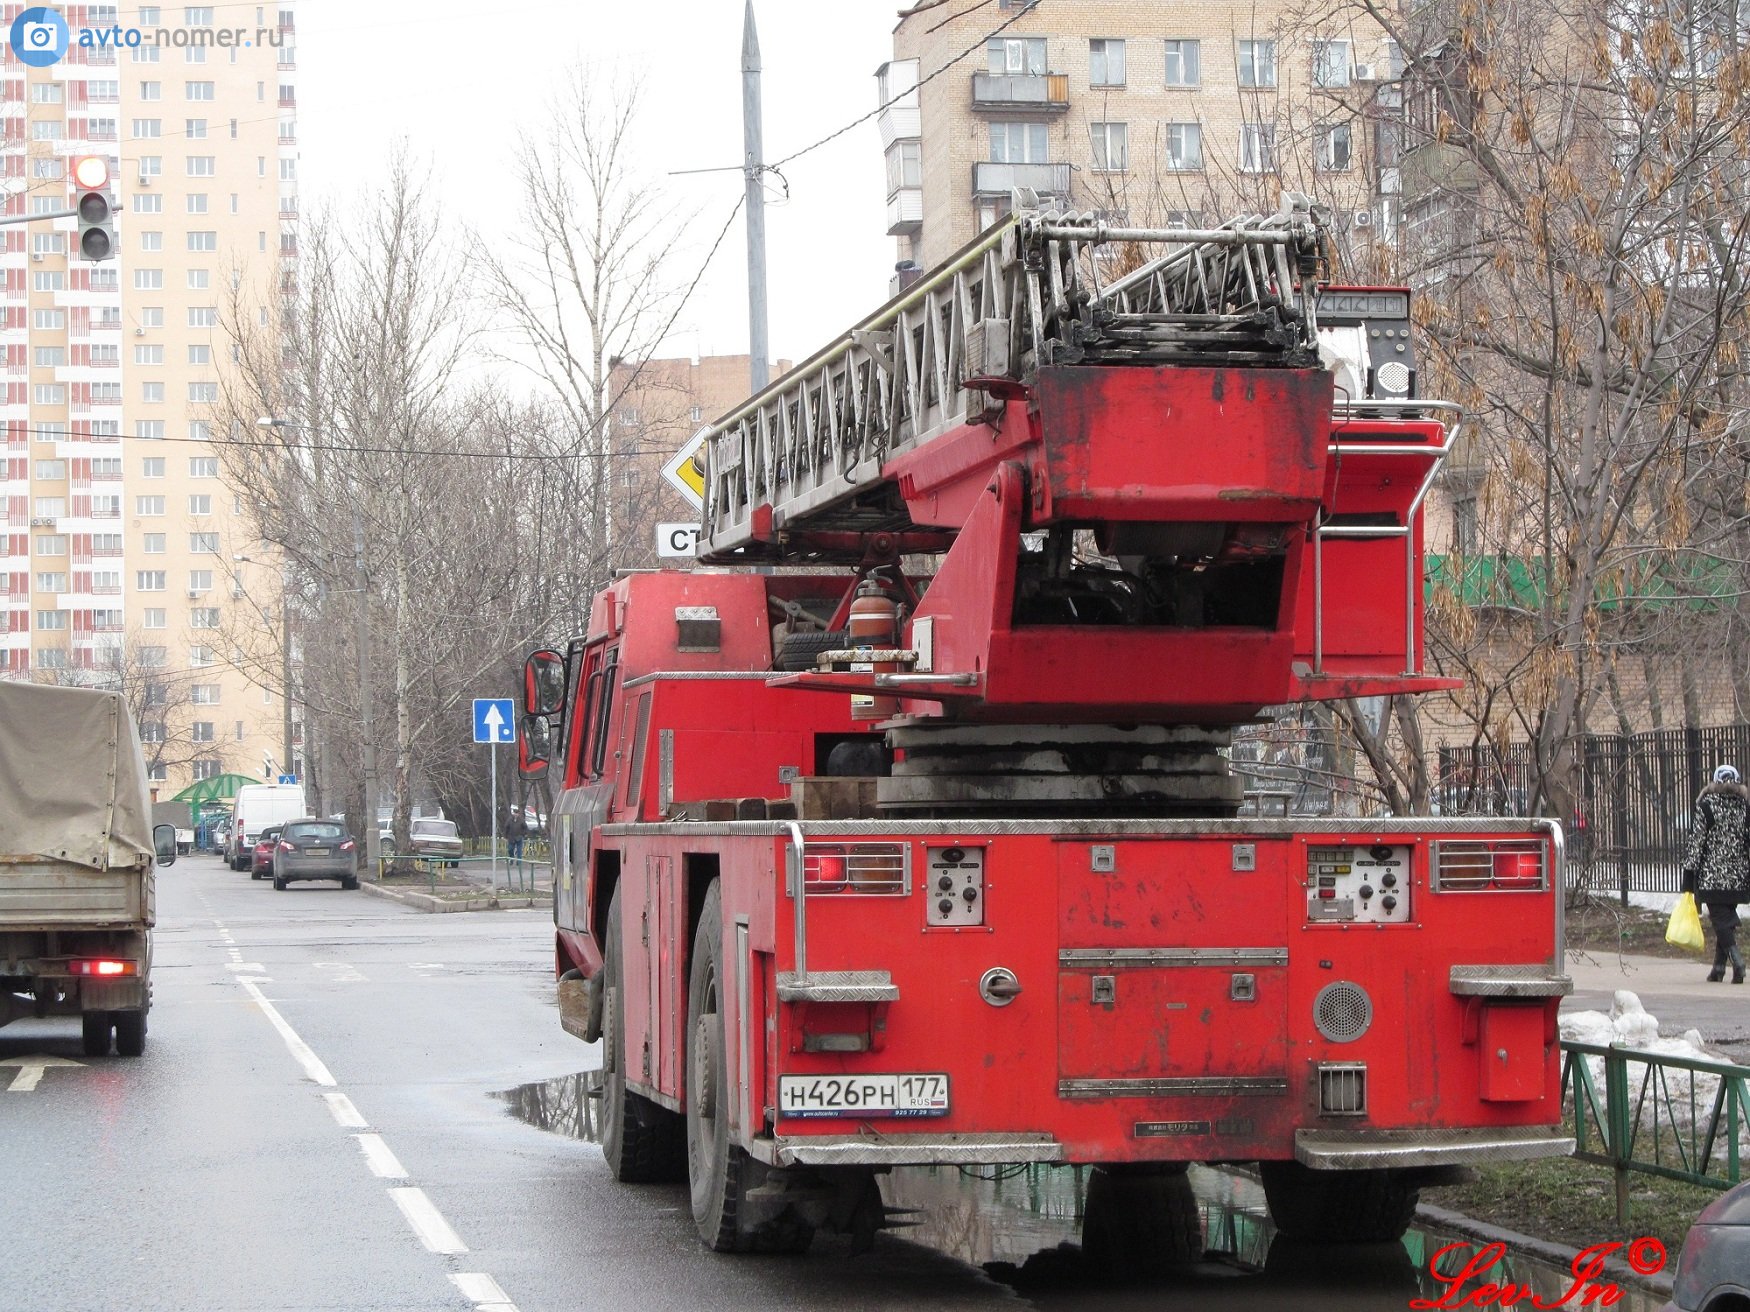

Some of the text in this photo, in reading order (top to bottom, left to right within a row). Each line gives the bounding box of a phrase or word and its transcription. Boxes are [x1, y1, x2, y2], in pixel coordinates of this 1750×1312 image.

[791, 1077, 941, 1107] Н426РН 177
[910, 1098, 930, 1106] RUS
